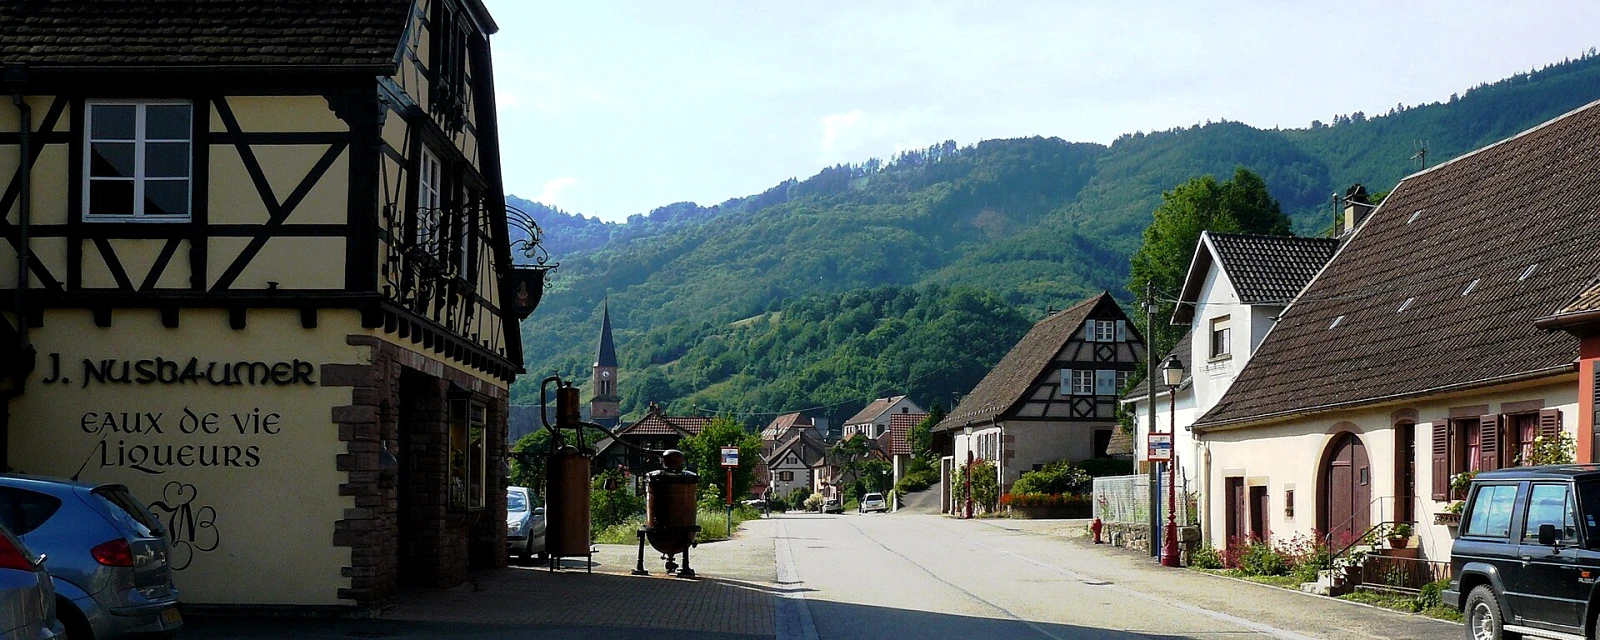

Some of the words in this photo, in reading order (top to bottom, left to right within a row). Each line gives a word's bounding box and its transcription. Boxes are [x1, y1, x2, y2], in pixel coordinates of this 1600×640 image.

[42, 353, 71, 384] J.
[82, 357, 317, 389] NUSBAUMER
[81, 411, 165, 435] EAUX
